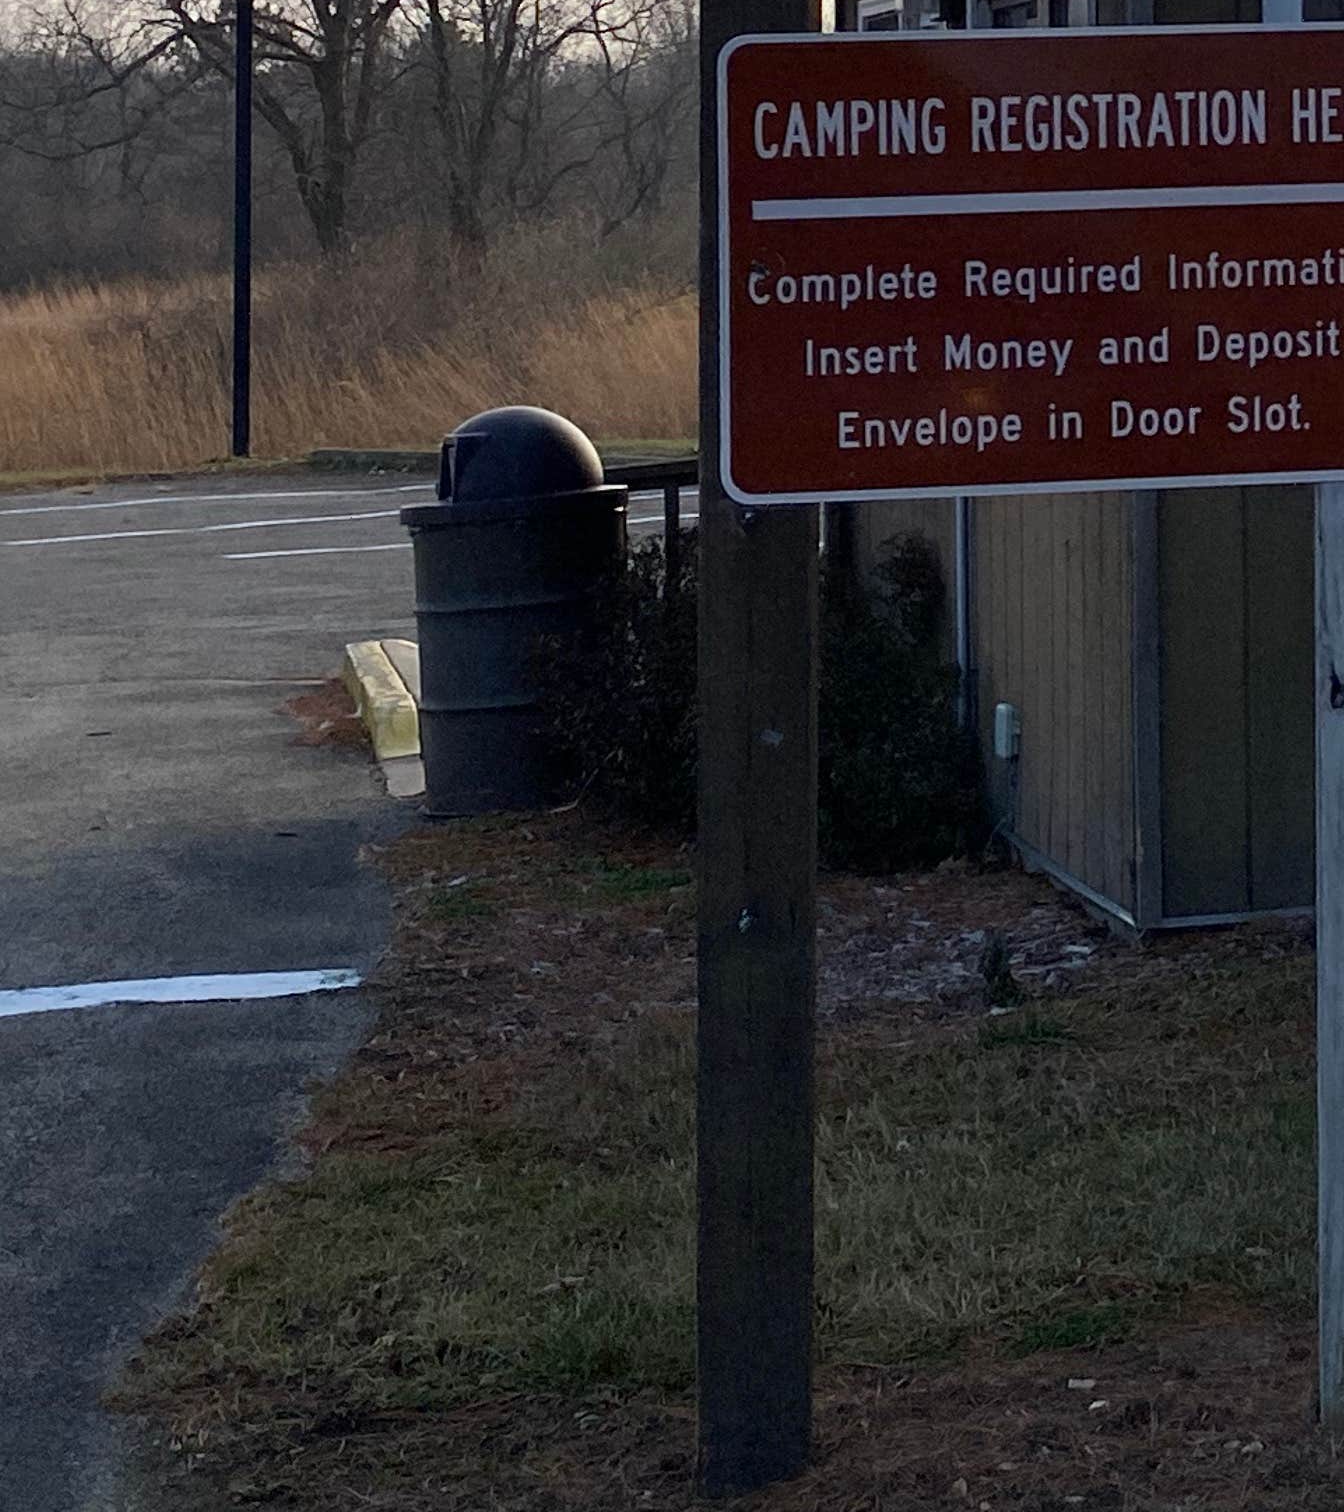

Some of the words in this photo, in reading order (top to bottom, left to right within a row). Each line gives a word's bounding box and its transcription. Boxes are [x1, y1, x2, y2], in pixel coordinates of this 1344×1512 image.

[754, 98, 946, 159] CAMPING
[971, 88, 1267, 153] REGISTRATION
[748, 262, 937, 310] Complete
[964, 255, 1141, 304] Required
[805, 338, 918, 376] Insert
[944, 333, 1073, 376] Money
[1099, 326, 1169, 365] and
[1198, 321, 1341, 368] Deposit
[838, 408, 1022, 453] Envelope
[1049, 402, 1083, 441] in
[1111, 400, 1201, 438] Door
[1227, 393, 1311, 434] Slot.
